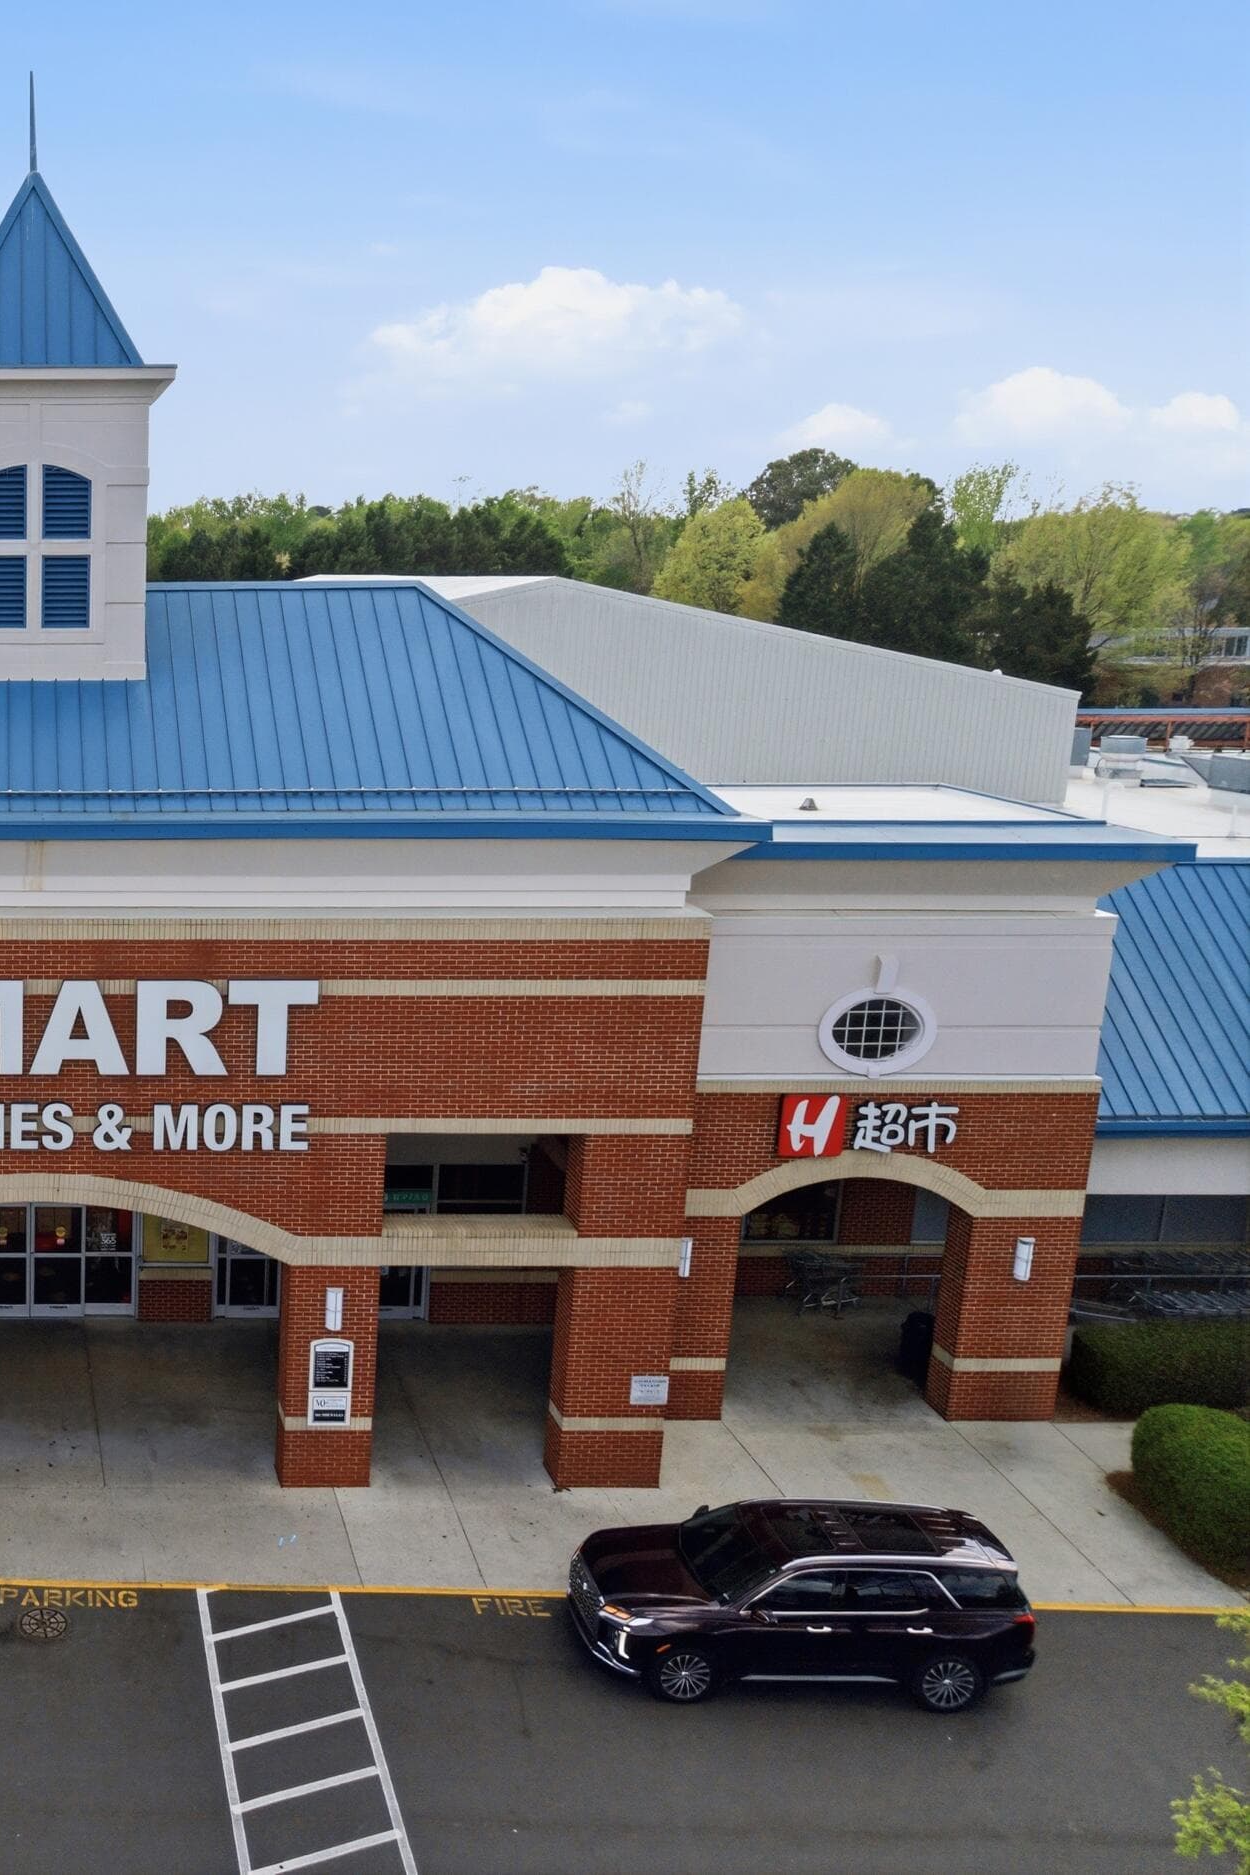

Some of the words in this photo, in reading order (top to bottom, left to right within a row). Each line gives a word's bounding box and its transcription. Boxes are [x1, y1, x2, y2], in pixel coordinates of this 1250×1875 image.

[92, 1101, 132, 1152] &
[152, 1101, 310, 1152] MORE
[787, 1095, 841, 1156] H
[853, 1102, 959, 1153] 超市
[471, 1597, 551, 1617] FIRE
